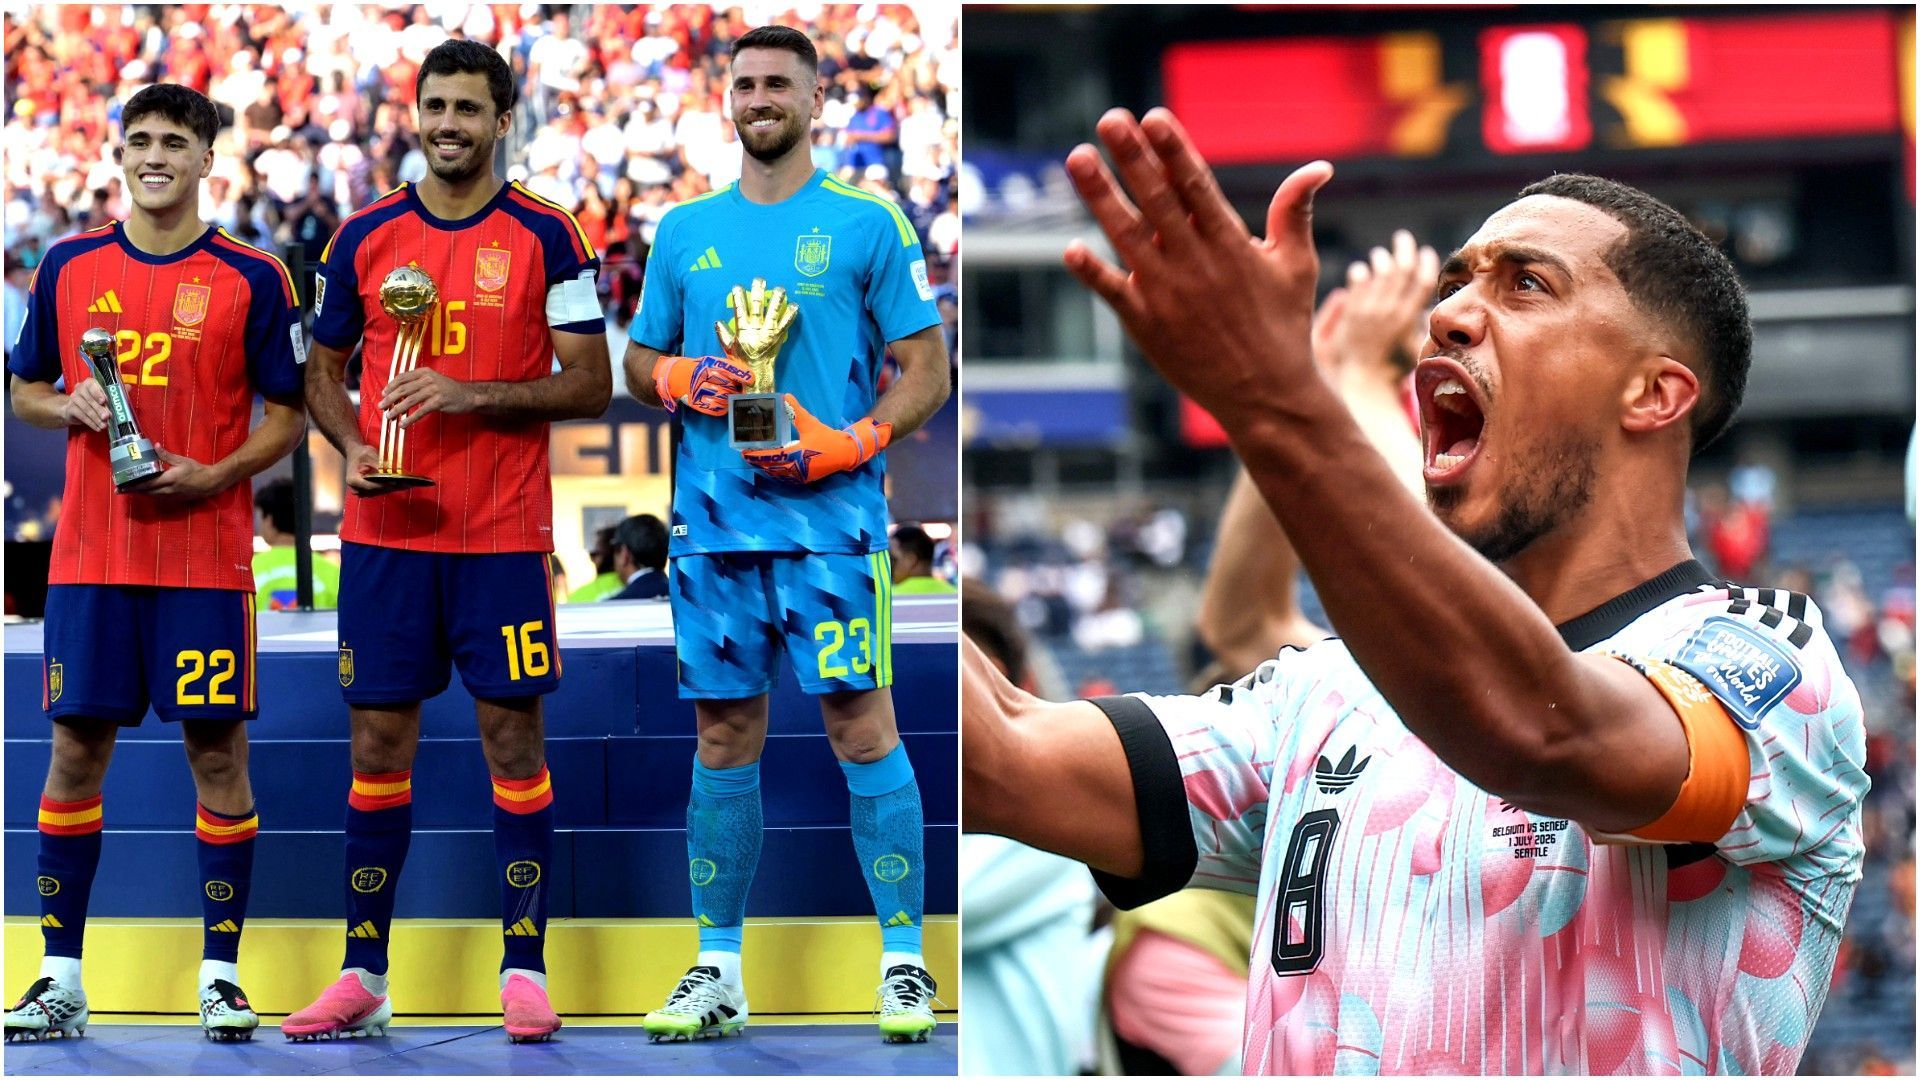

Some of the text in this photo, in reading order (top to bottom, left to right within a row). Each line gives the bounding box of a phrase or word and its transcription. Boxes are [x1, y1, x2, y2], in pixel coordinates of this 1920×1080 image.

[431, 301, 467, 357] 16
[115, 329, 172, 387] 22
[713, 360, 751, 381] reusch
[109, 385, 127, 422] aramco
[502, 620, 549, 681] 16
[815, 617, 872, 679] 23
[176, 649, 236, 705] 22
[1492, 824, 1525, 837] BELGIUM
[1527, 822, 1537, 833] VS
[1513, 835, 1533, 847] JULY
[1534, 833, 1556, 845] 2026
[1514, 847, 1549, 858] SEATTLE
[1271, 808, 1341, 977] 8
